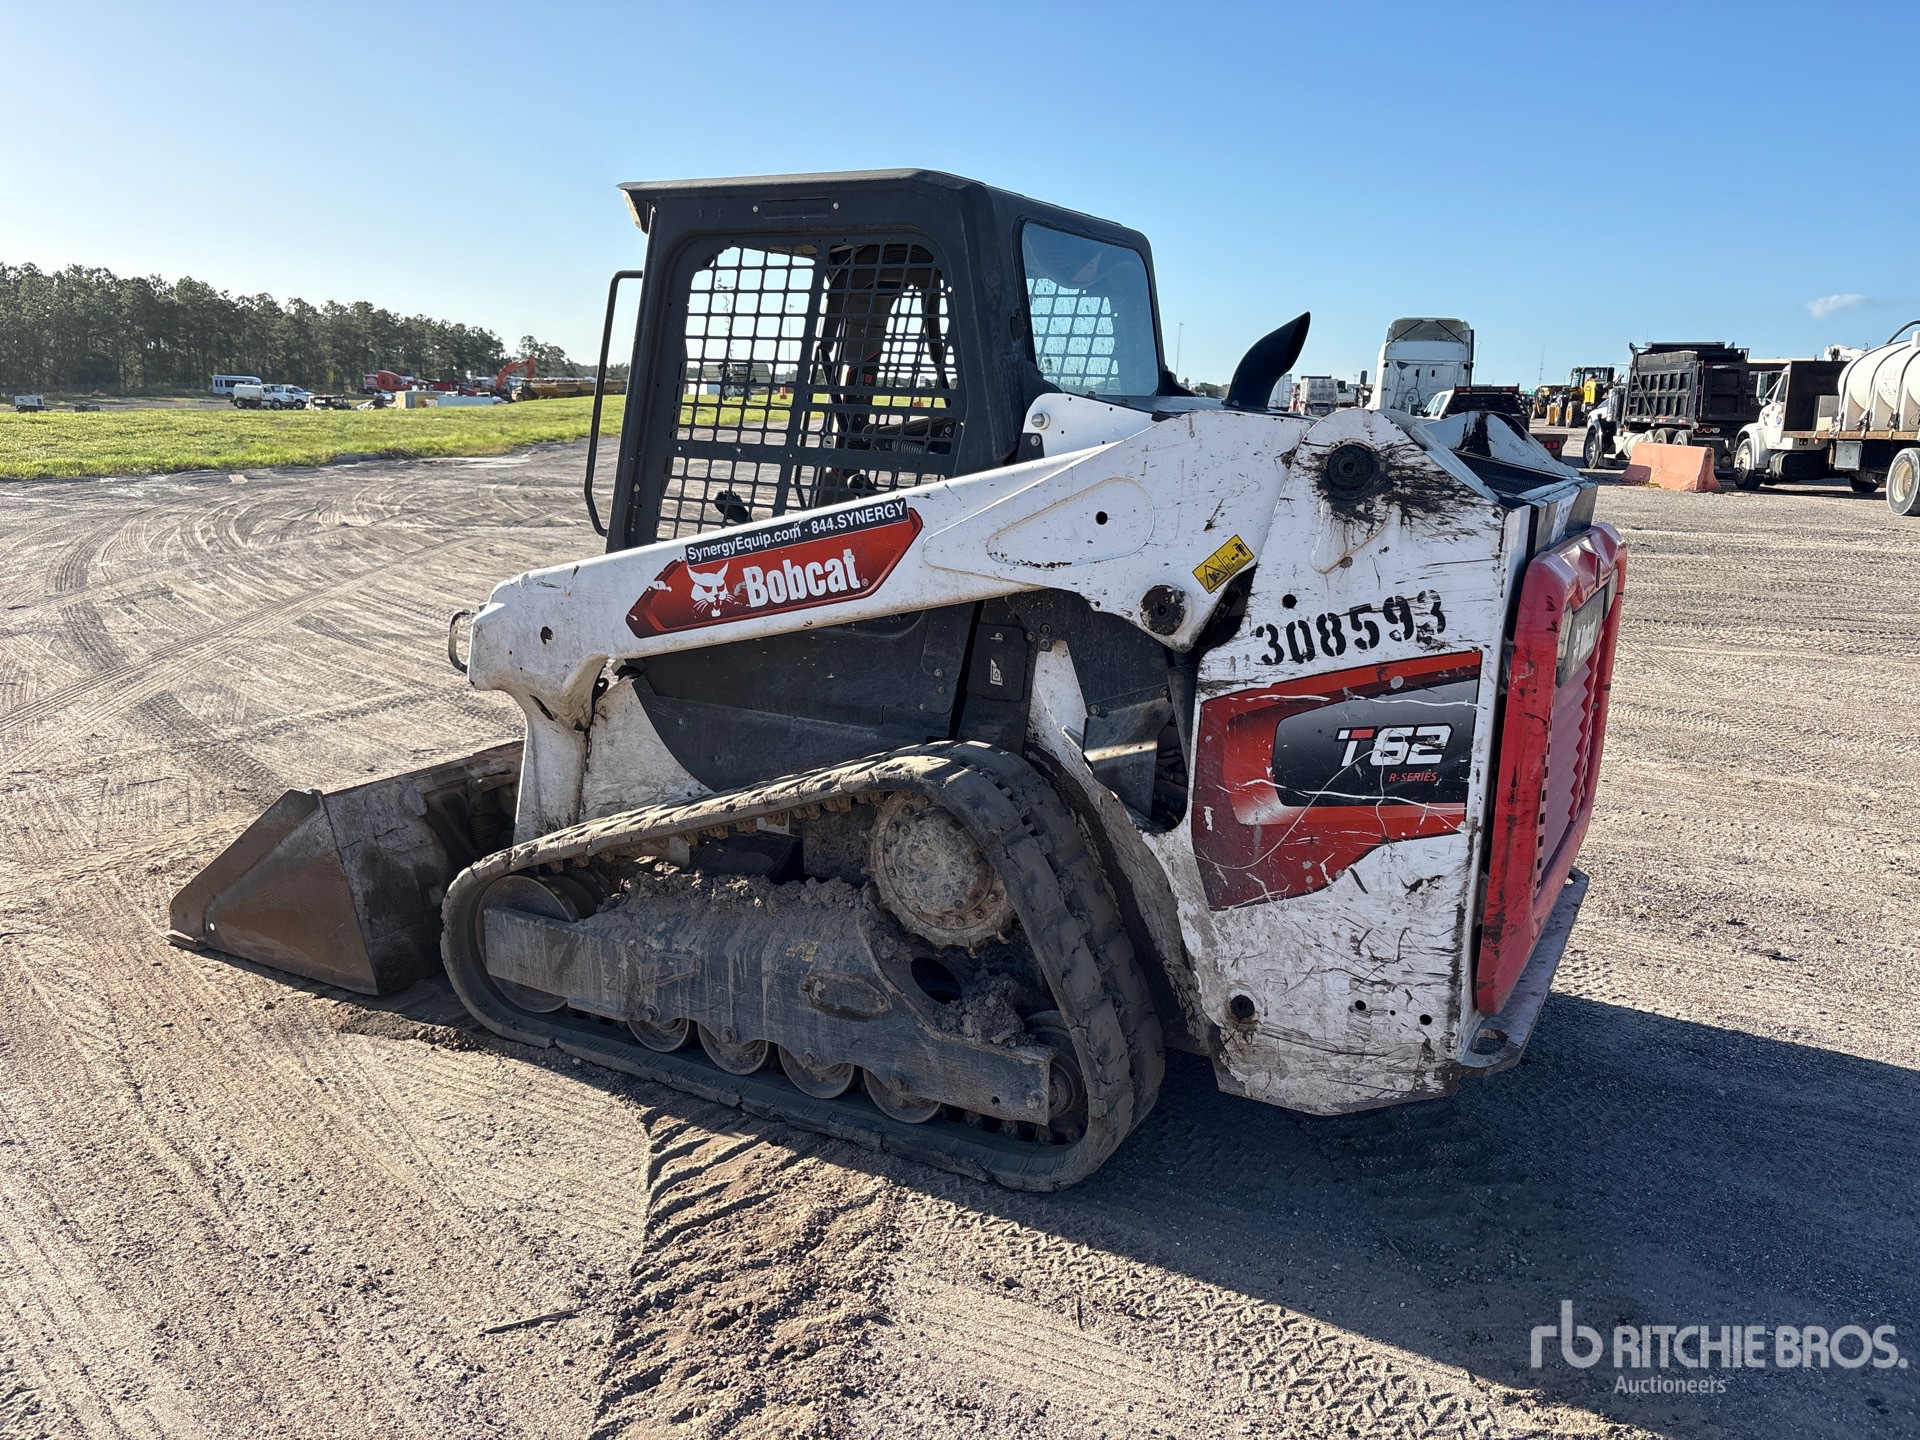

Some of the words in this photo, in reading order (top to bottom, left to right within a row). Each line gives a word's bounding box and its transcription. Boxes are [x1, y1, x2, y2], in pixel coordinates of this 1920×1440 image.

[687, 524, 801, 562] SynergyEquip.com
[811, 501, 905, 535] 844.SYNERGY
[743, 548, 860, 609] Bobcat
[1255, 589, 1446, 665] 308593
[1336, 725, 1452, 767] T62
[1388, 771, 1438, 783] R-SERIES
